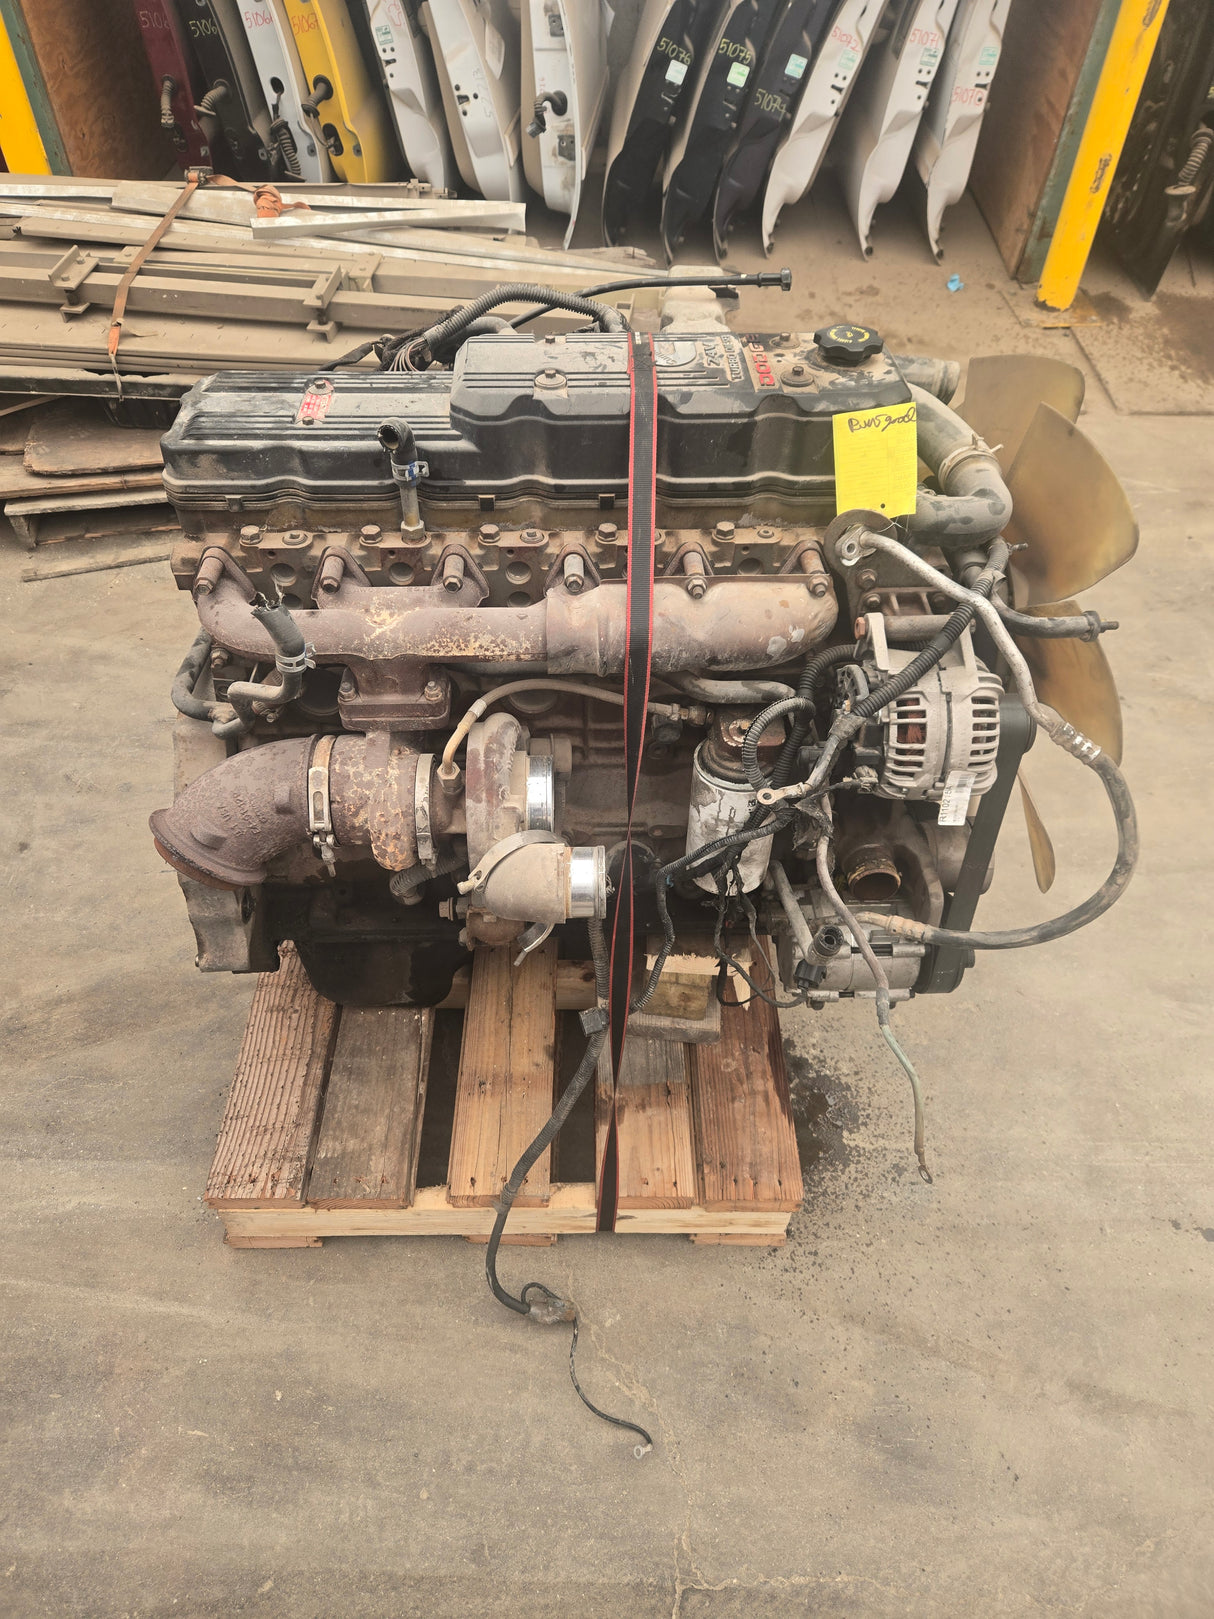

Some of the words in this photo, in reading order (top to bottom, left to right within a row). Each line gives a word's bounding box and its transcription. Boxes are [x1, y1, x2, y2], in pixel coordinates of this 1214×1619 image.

[657, 37, 692, 65] 51076
[719, 38, 752, 65] 51075
[754, 88, 787, 122] 51074
[951, 86, 984, 106] 51070
[702, 343, 720, 366] 24V
[727, 354, 742, 380] TURBO
